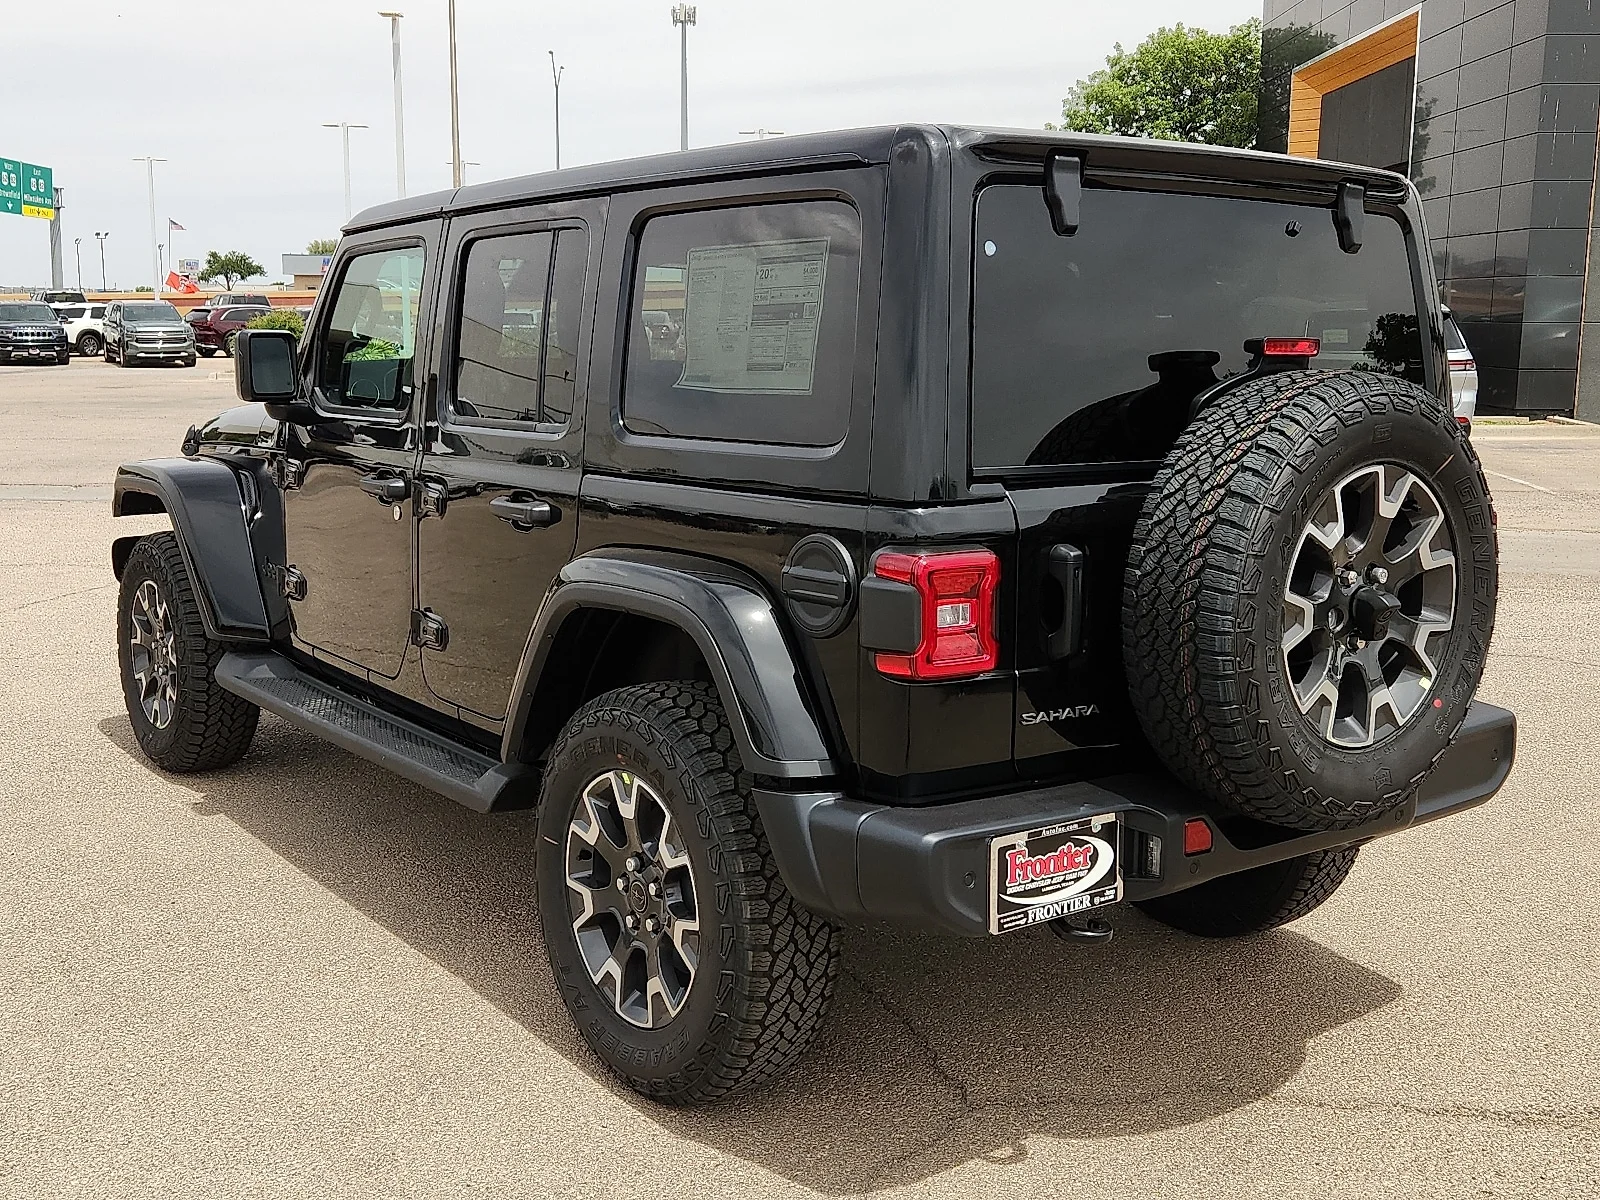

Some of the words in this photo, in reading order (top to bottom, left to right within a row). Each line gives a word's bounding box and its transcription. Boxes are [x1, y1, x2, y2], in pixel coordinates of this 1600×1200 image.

[760, 268, 770, 280] 20
[1452, 475, 1491, 692] GENERAL
[1020, 704, 1100, 726] SAHARA
[570, 736, 677, 805] GENERAL
[1006, 843, 1093, 886] Frontier
[1027, 894, 1092, 923] FRONTIER
[588, 1018, 690, 1068] GRABBER
